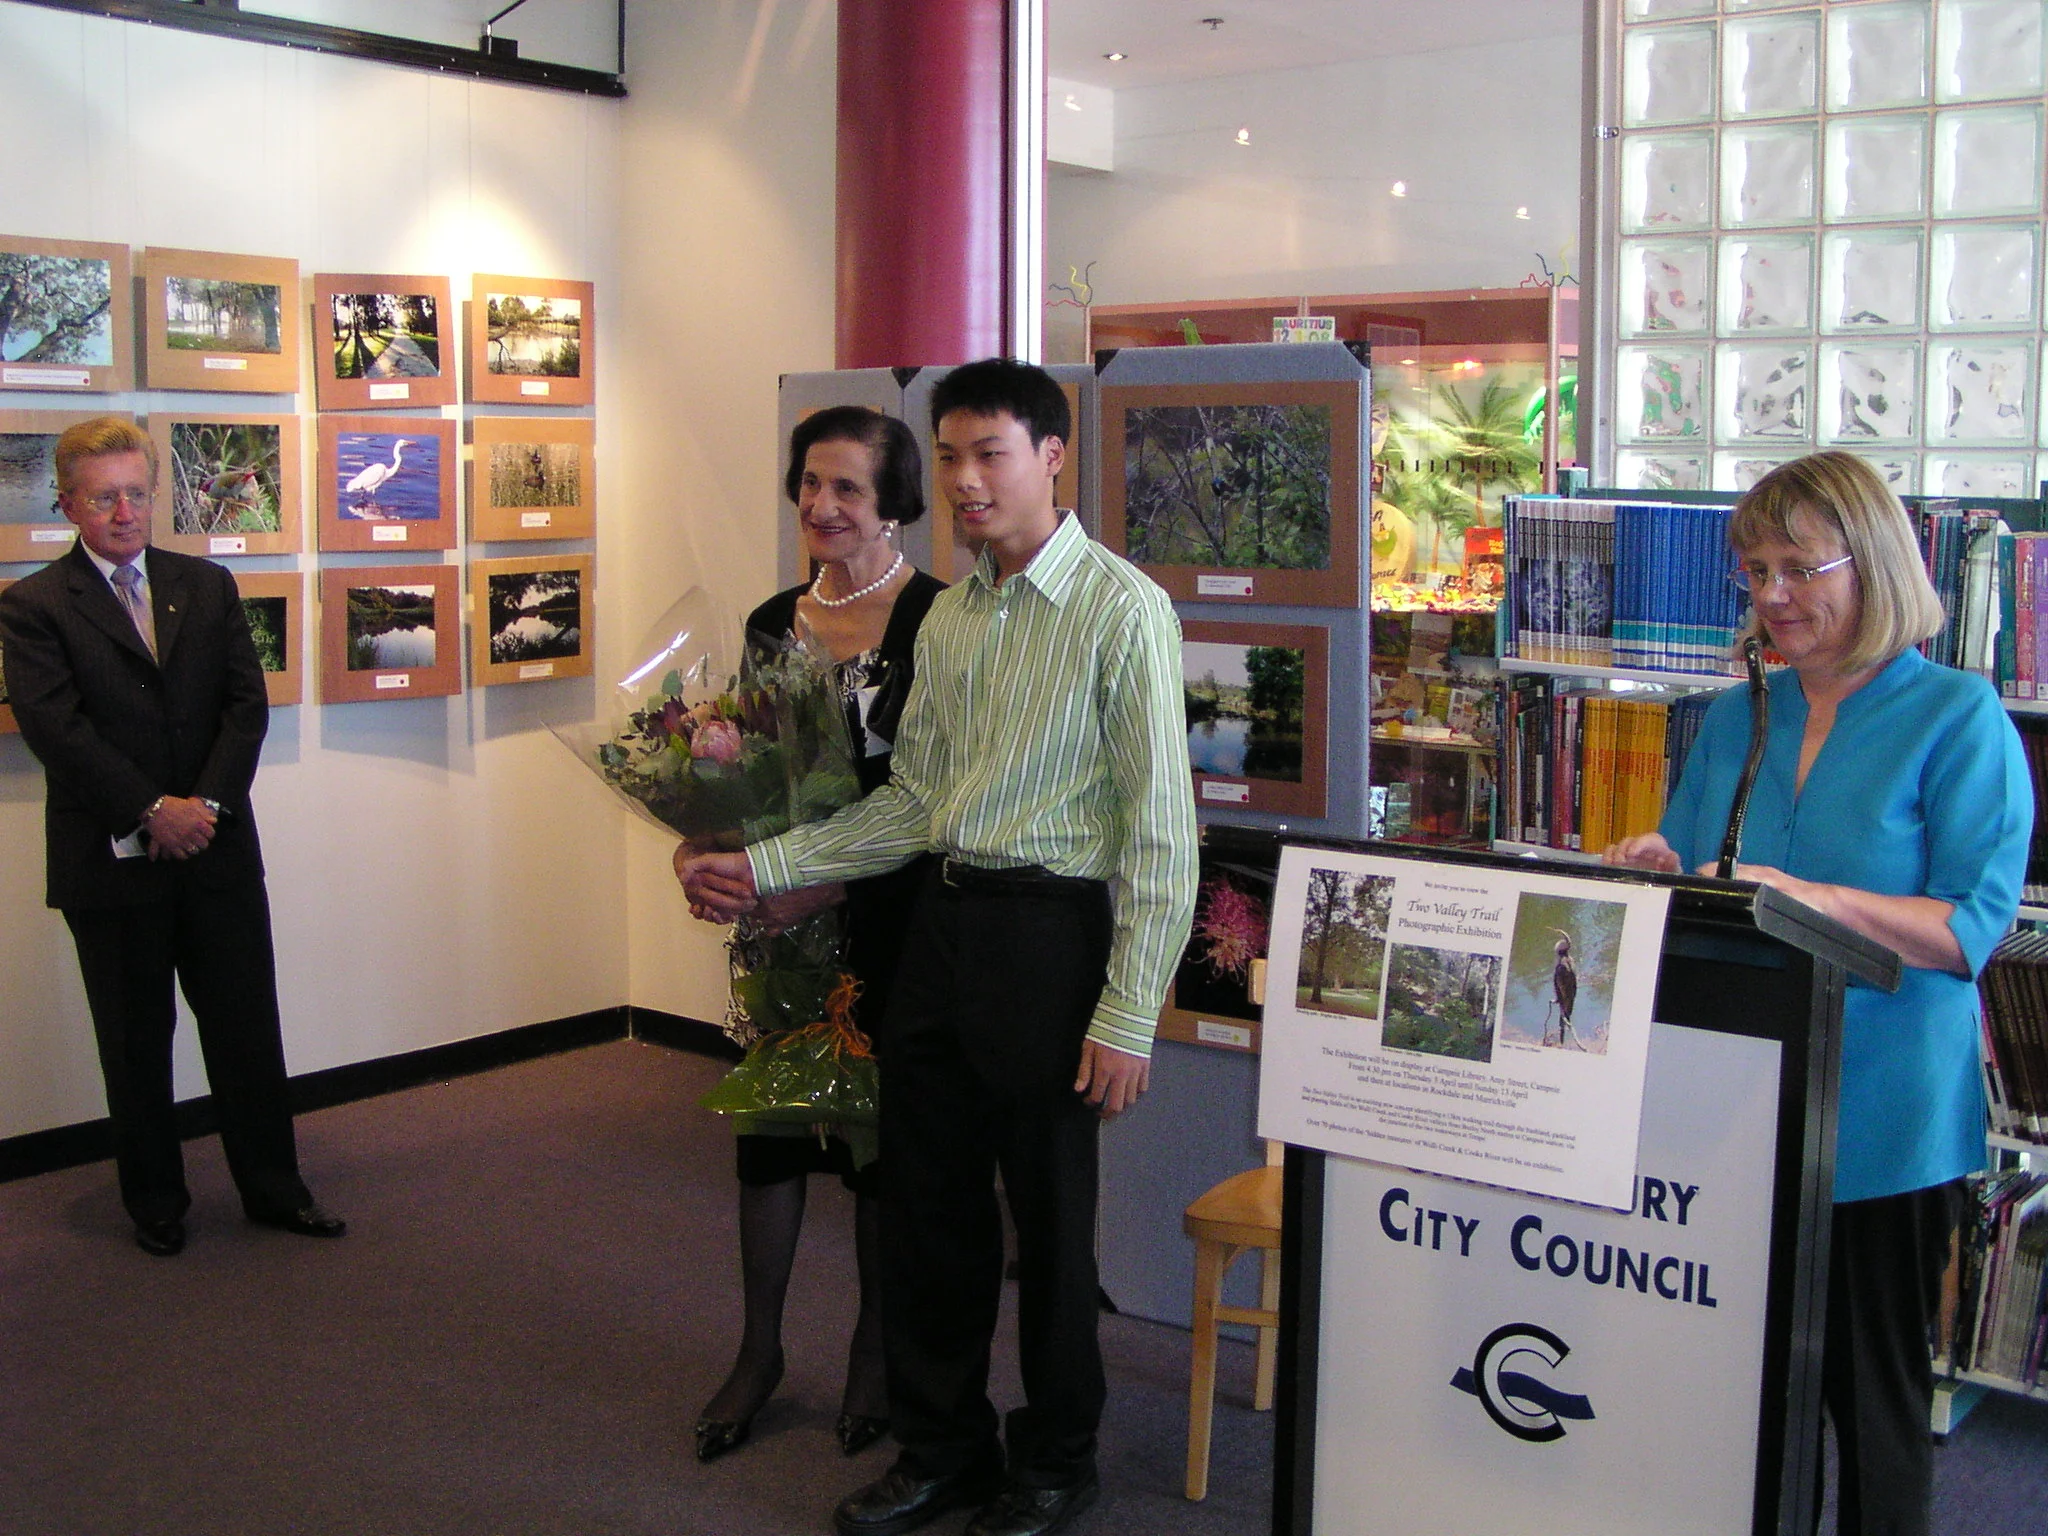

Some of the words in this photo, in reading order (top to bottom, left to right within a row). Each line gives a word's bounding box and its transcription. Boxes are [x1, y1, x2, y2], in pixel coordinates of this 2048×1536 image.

[1274, 318, 1332, 330] MAURITIUS
[1407, 898, 1430, 913] Two
[1434, 902, 1467, 922] Valley
[1470, 906, 1503, 922] Trail
[1398, 917, 1455, 934] Photographic
[1456, 925, 1502, 940] Exhibition
[1321, 1047, 1333, 1055] The
[1334, 1050, 1367, 1061] Exhibition
[1399, 1061, 1423, 1071] display
[1432, 1067, 1460, 1078] Campsie
[1529, 1083, 1560, 1095] Campsie
[1348, 1062, 1365, 1071] From
[1440, 1078, 1456, 1087] April
[1457, 1081, 1473, 1089] until
[1510, 1091, 1528, 1100] April
[1392, 1081, 1420, 1091] locations
[1430, 1088, 1460, 1098] Rockdale
[1461, 1093, 1473, 1101] and
[1475, 1095, 1516, 1108] Marrickville
[1379, 1188, 1480, 1257] CITY
[1510, 1214, 1717, 1308] COUNCIL
